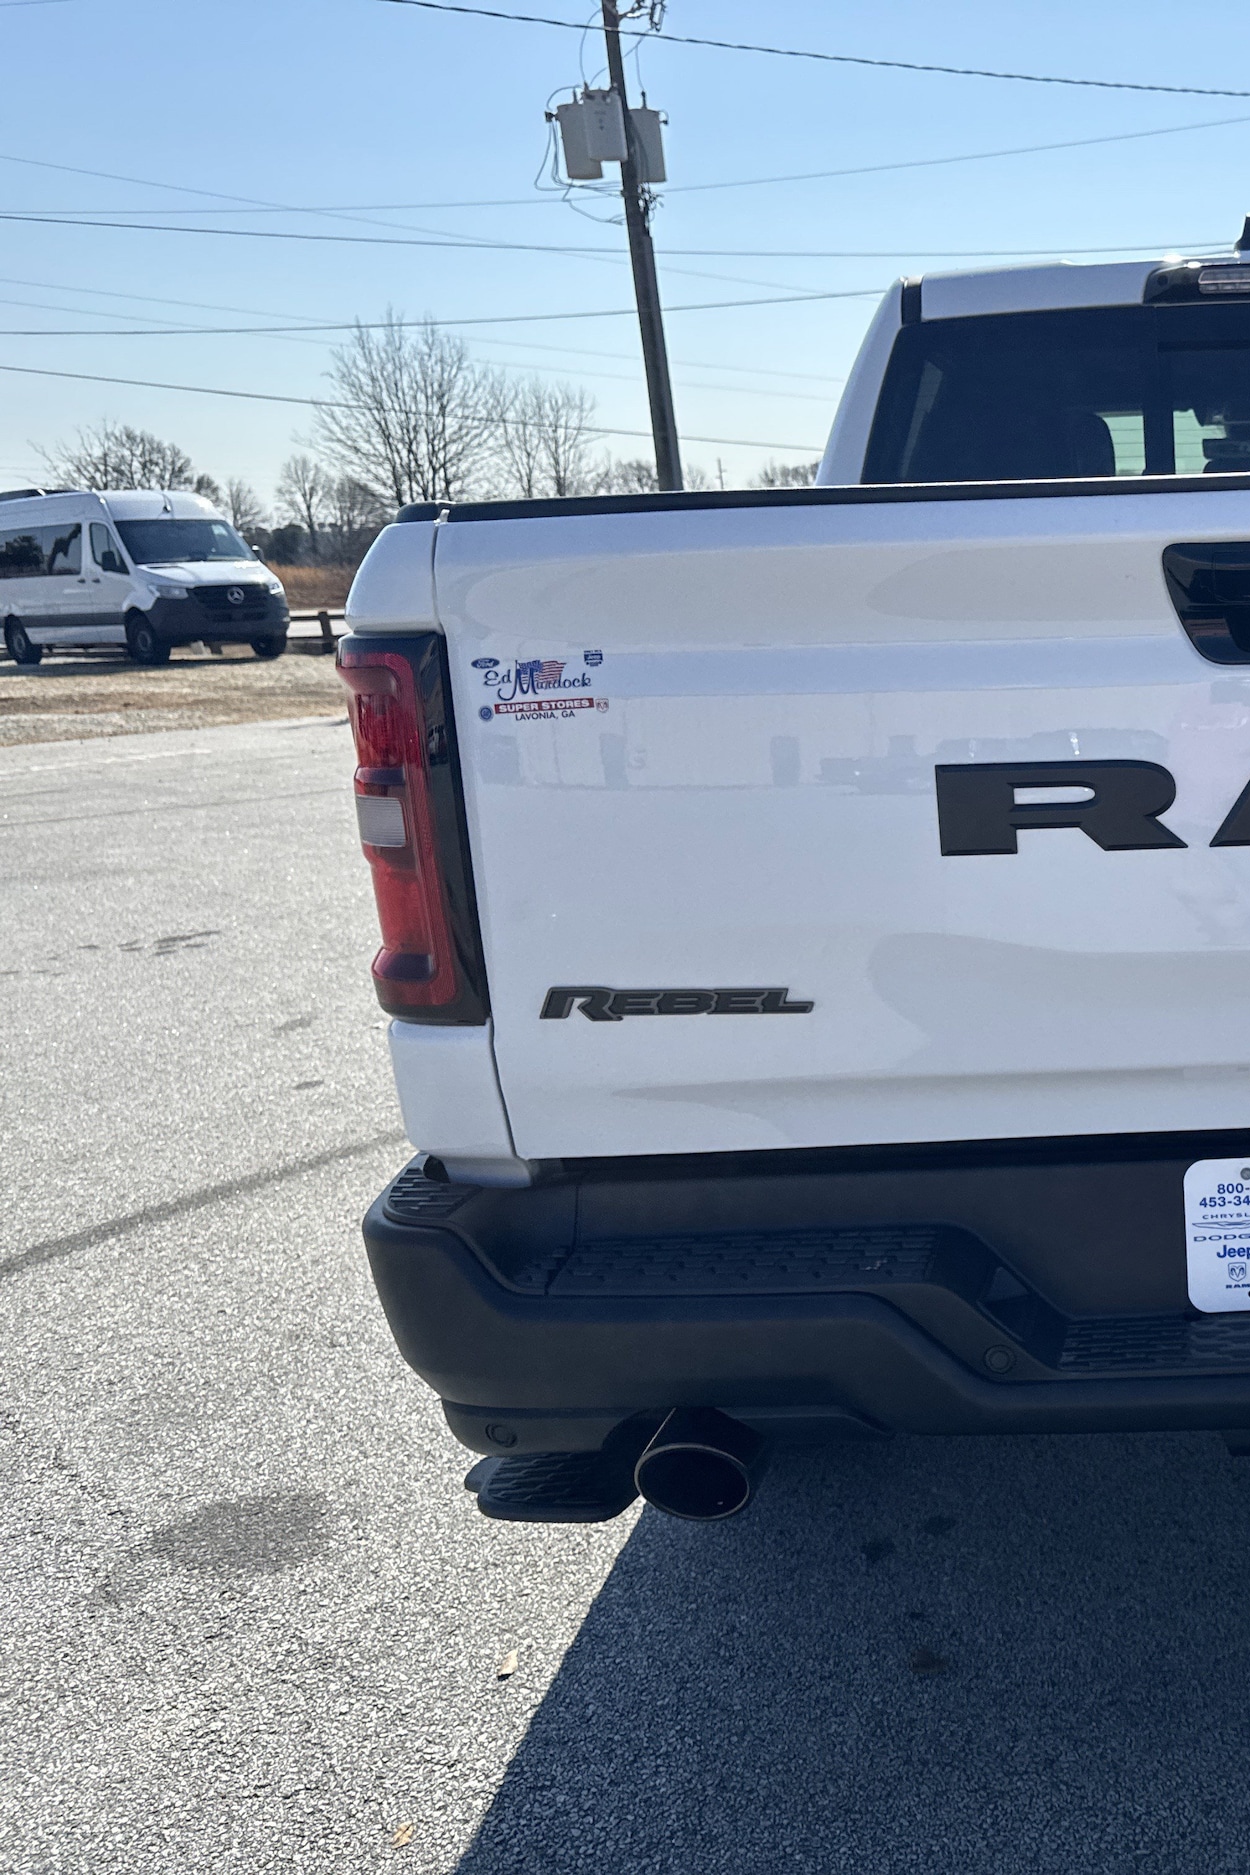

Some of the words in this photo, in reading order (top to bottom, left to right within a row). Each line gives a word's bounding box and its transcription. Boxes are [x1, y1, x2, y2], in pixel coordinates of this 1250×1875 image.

[483, 670, 512, 686] Ed
[497, 661, 592, 701] Murdock
[499, 702, 538, 713] SUPER
[541, 699, 590, 710] STORES
[515, 712, 559, 721] LAVONIA,
[561, 710, 576, 718] GA
[1217, 1182, 1250, 1195] 800-
